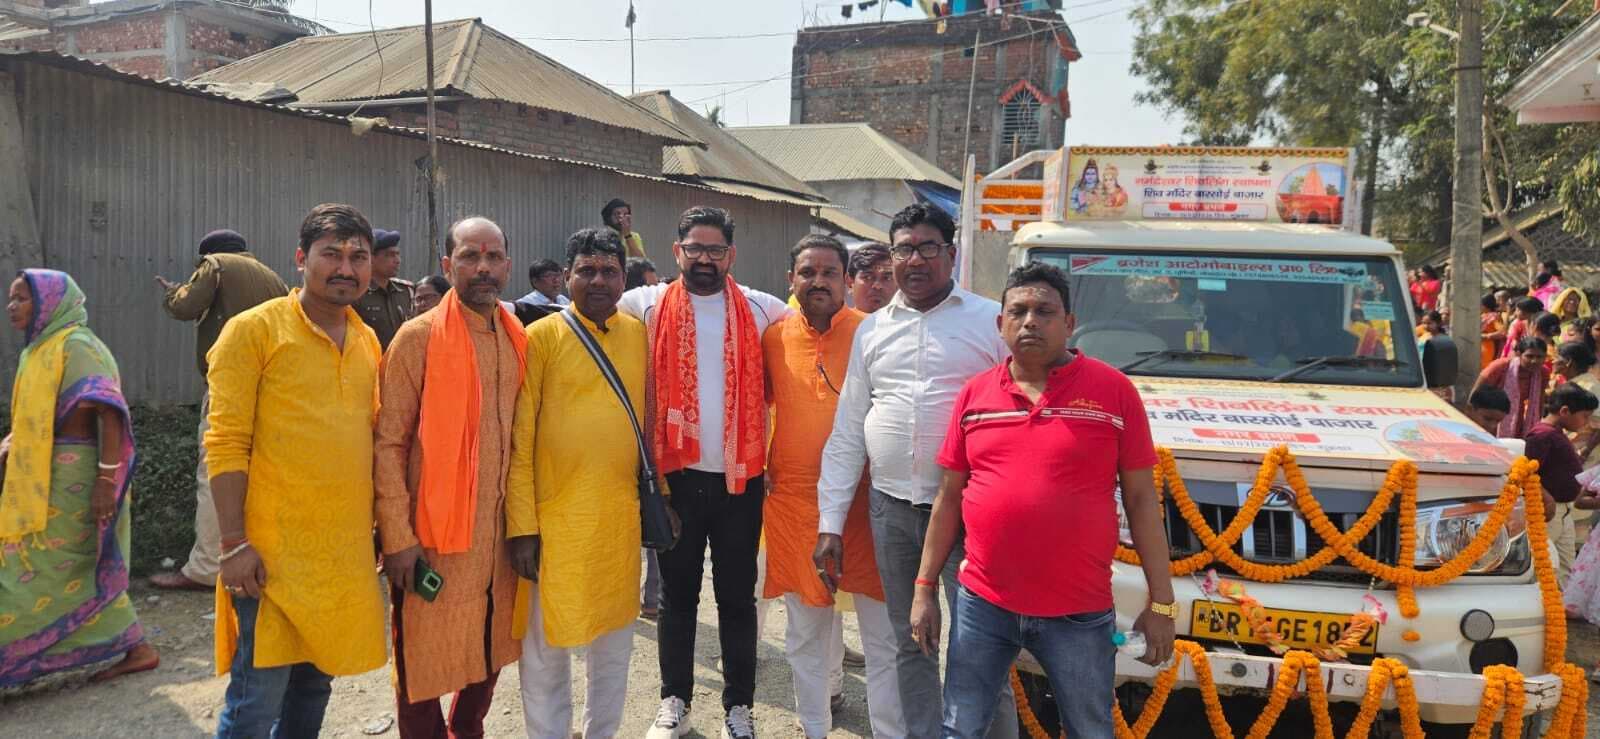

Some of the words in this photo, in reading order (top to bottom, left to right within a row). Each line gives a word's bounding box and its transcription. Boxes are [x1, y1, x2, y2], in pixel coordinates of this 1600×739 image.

[1144, 187, 1164, 198] शिव
[1166, 188, 1192, 198] मंदिर
[1194, 188, 1231, 199] बारसोई
[1233, 192, 1264, 200] बाजार
[1187, 397, 1322, 413] शिवलिंग
[1332, 406, 1450, 418] स्थापना
[1162, 409, 1219, 423] मंदिर
[1221, 413, 1302, 426] बारसोई
[1305, 417, 1378, 430] बाजार
[1209, 609, 1374, 647] BRGE182
